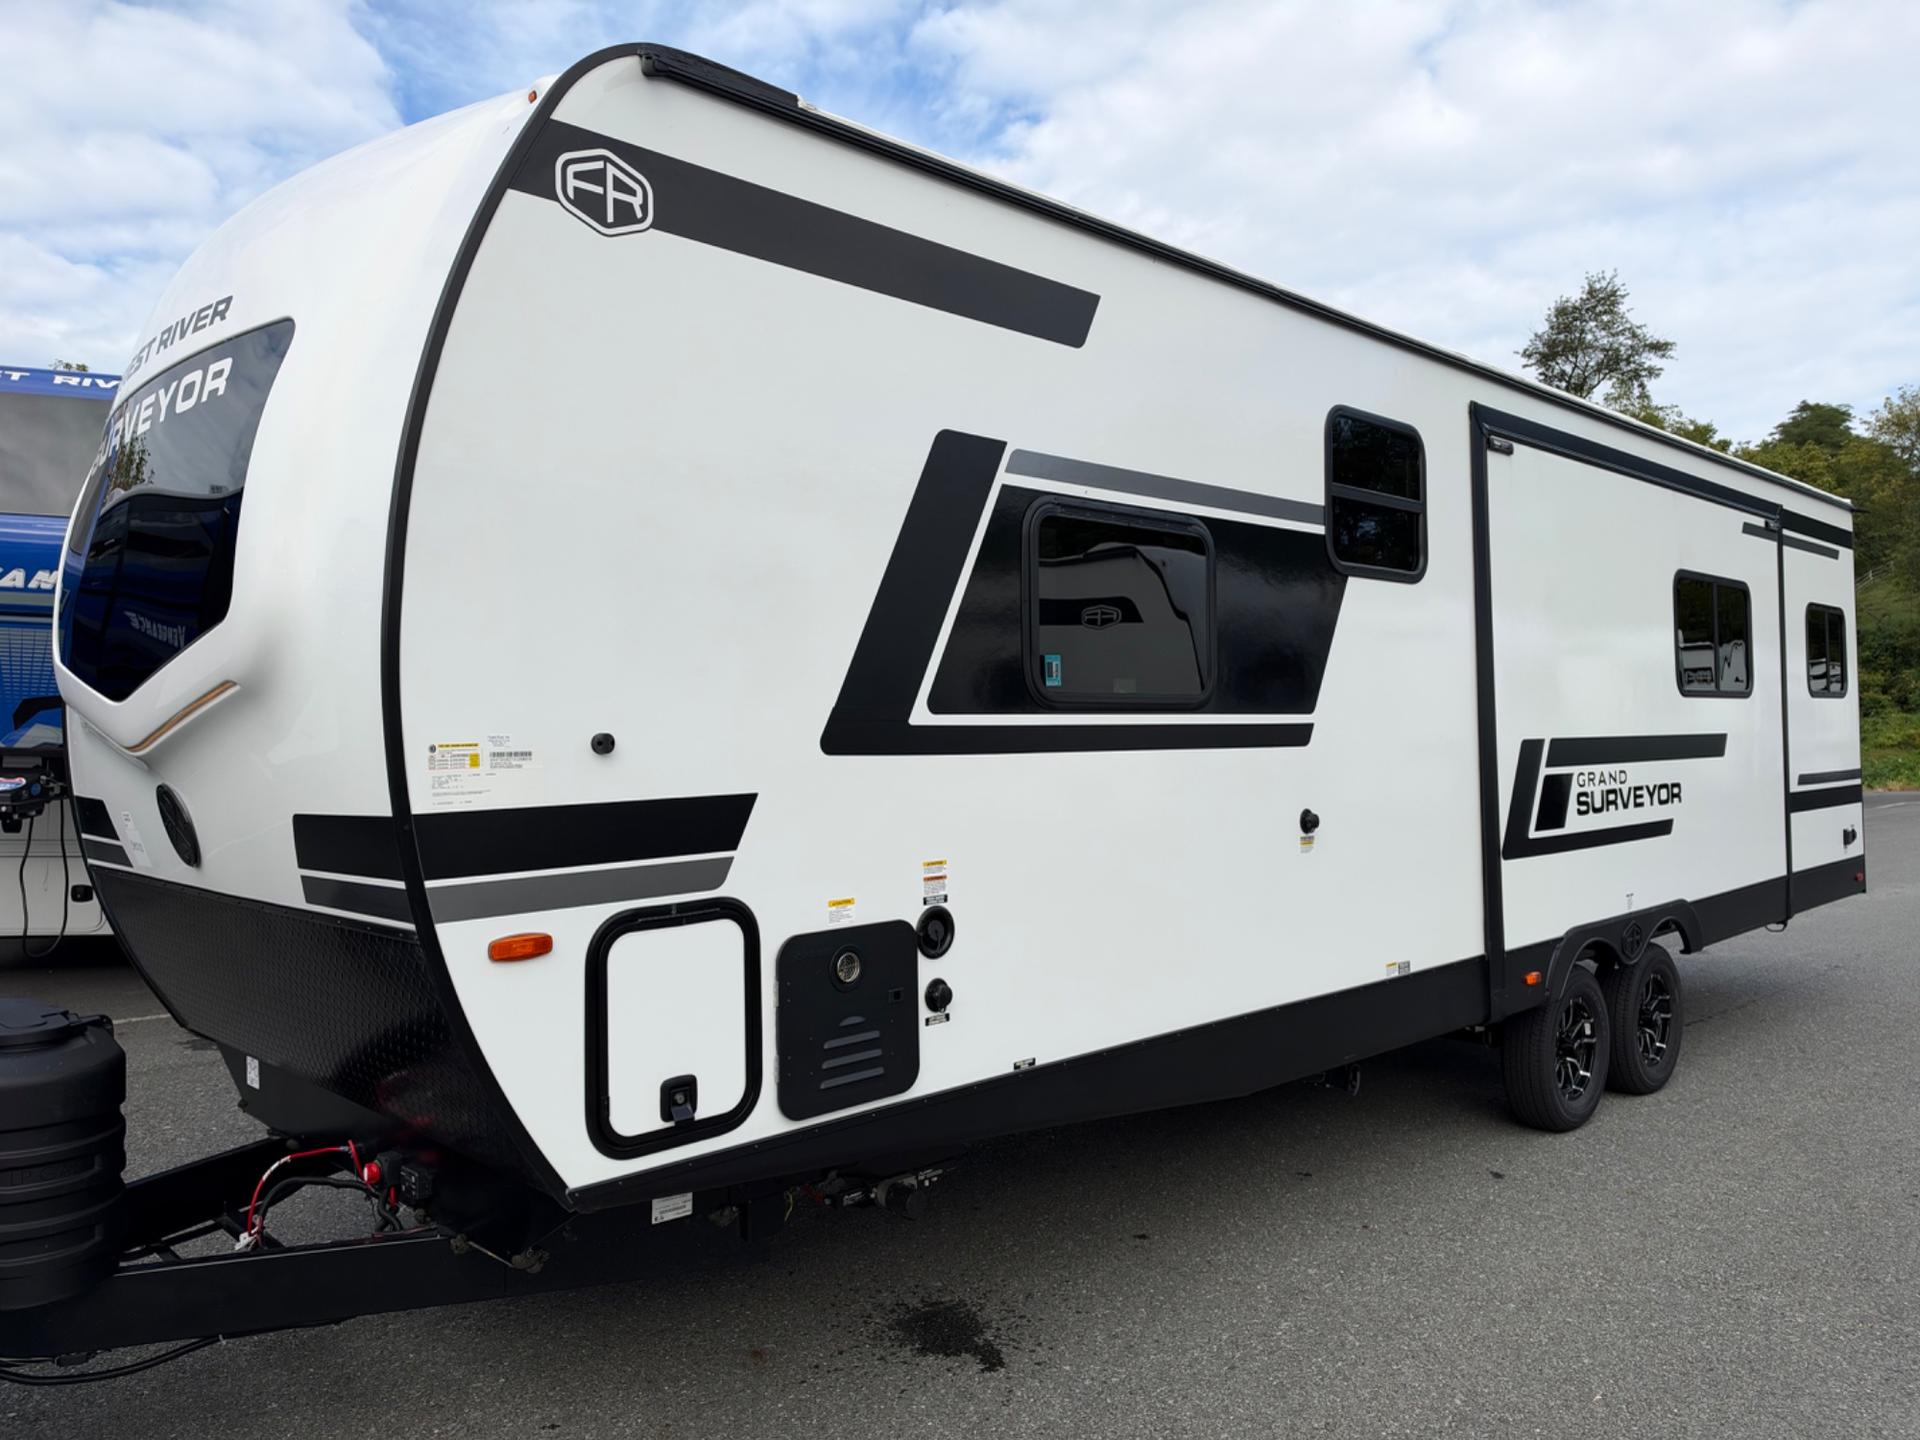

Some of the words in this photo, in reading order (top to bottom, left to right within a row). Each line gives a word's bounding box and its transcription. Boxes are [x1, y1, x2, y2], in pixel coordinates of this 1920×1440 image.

[566, 160, 643, 223] FR
[126, 335, 158, 381] EST
[156, 295, 234, 354] RIVER
[0, 369, 31, 381] T
[1576, 769, 1628, 788] GRAND
[1576, 782, 1683, 816] SURVEYOR
